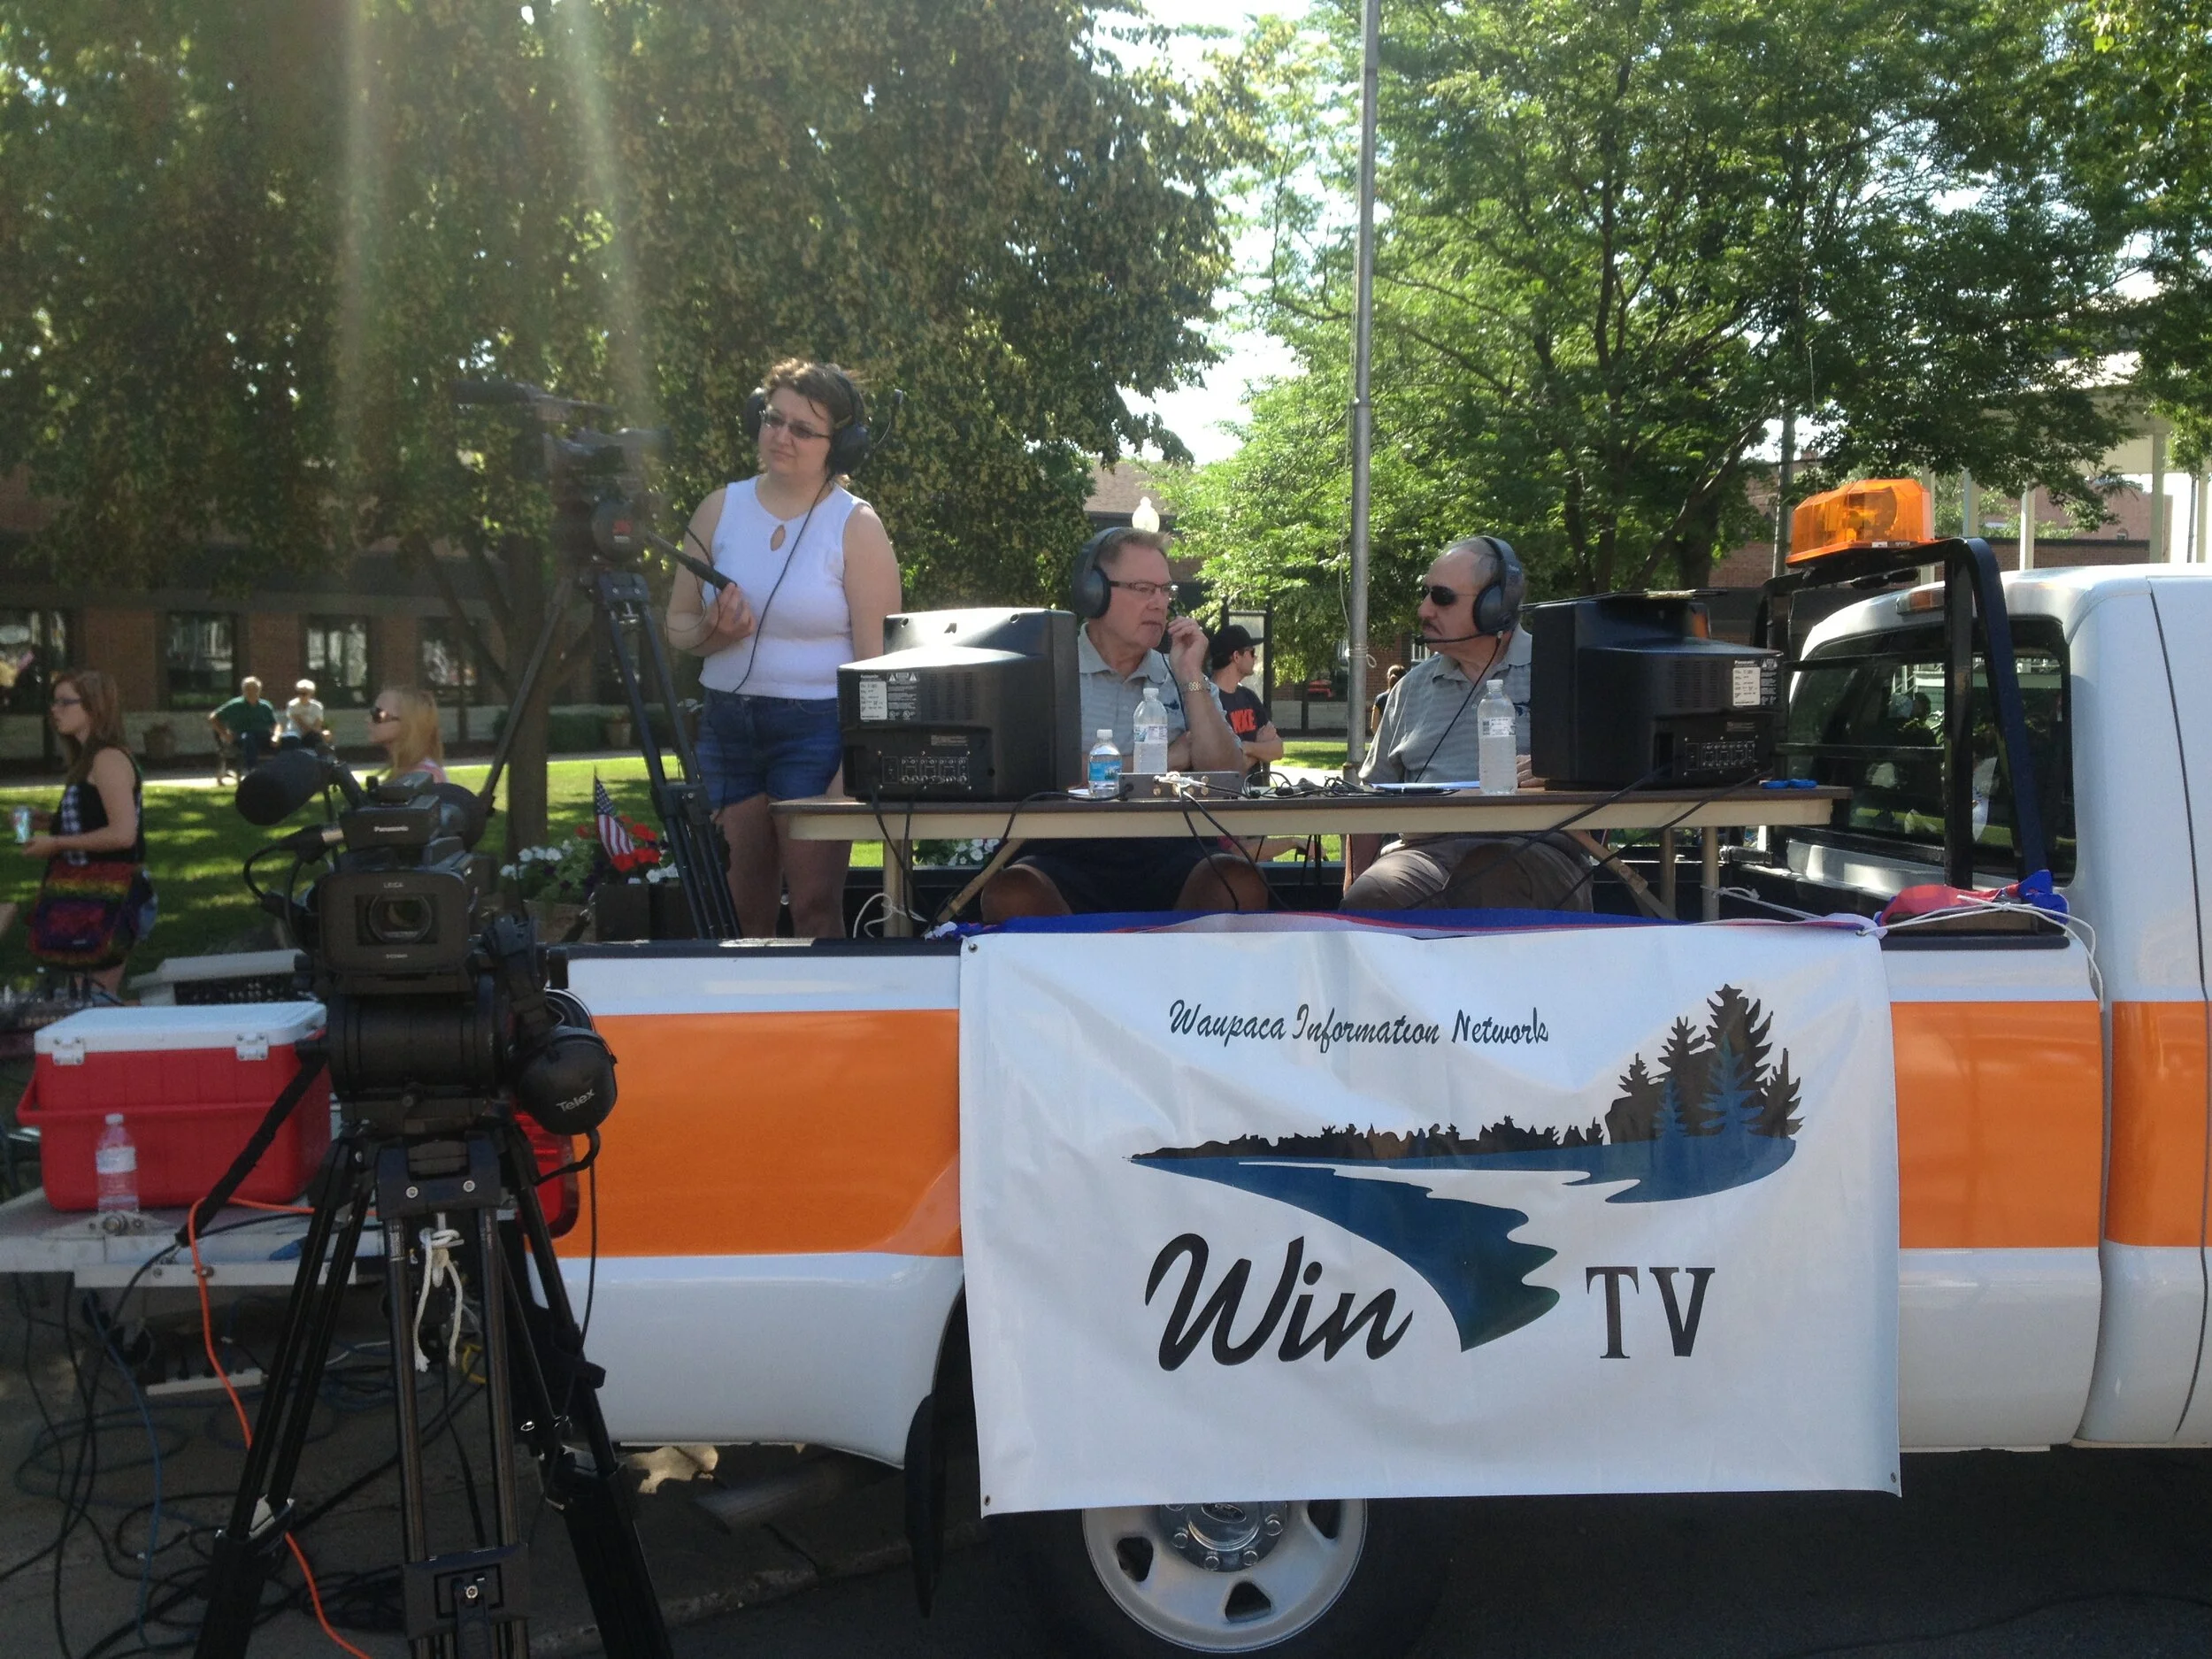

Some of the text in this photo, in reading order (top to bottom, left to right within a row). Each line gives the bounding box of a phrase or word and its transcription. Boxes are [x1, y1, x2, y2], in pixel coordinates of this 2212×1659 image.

[1170, 999, 1549, 1053] Waupaca Information Network
[556, 1088, 595, 1112] Telex
[1144, 1233, 1716, 1371] Win TV
